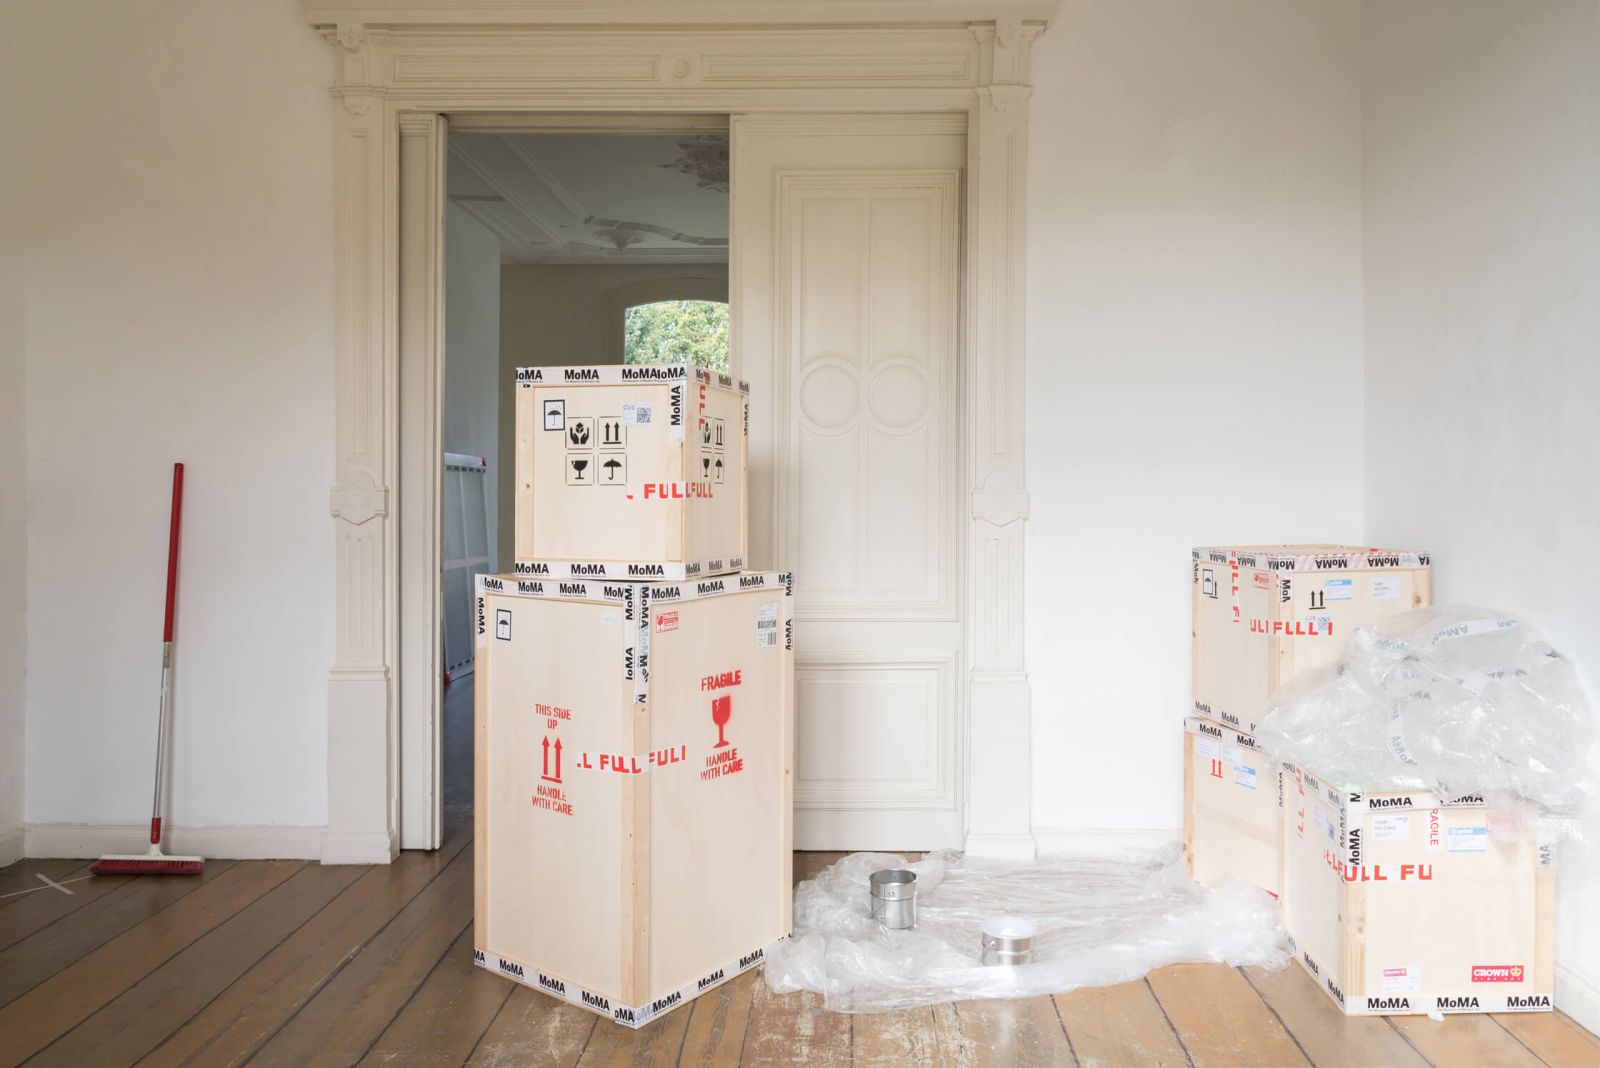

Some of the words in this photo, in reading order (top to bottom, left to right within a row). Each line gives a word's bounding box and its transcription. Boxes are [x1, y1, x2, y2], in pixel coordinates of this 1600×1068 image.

[564, 369, 600, 380] MoMA
[622, 368, 658, 379] MoMA
[671, 386, 681, 426] MoMA
[515, 563, 549, 574] MoMA
[571, 564, 606, 575] MoMA
[628, 565, 664, 575] MoMA
[685, 563, 700, 575] MoMA
[708, 560, 722, 571] MoMA
[730, 558, 742, 569] MoMA
[1237, 557, 1256, 568] MoMA
[1268, 560, 1295, 570] MoMA
[1315, 559, 1347, 569] MoMA
[1367, 557, 1399, 567] MoMA
[518, 582, 543, 593] MoMA
[560, 583, 586, 595] MoMA
[652, 587, 680, 599] MoMA
[697, 581, 724, 594] MoMA
[740, 576, 764, 587] MoMA
[641, 587, 649, 628] MoMA
[701, 669, 741, 691] FRAGILE
[535, 704, 552, 716] THIS
[554, 707, 571, 720] SIDE
[1195, 701, 1211, 714] MoMA
[1221, 711, 1239, 726] MoMA
[547, 719, 558, 730] UP
[1200, 724, 1222, 738] MoMA
[706, 749, 737, 767] HANDLE
[701, 766, 720, 781] WITH
[723, 758, 743, 775] CARE
[537, 785, 566, 801] HANDLE
[532, 796, 550, 809] WITH
[553, 802, 573, 816] CARE
[1369, 797, 1412, 808] MoMA
[1401, 864, 1432, 880] FU
[652, 991, 681, 1012] MoMA
[698, 969, 724, 988] MoMA
[740, 948, 763, 968] MoMA
[1304, 952, 1319, 976] MoMA
[1328, 978, 1344, 1005] MoMA
[1473, 969, 1509, 977] CROWN
[500, 959, 524, 977] MoMA
[539, 974, 565, 993] MoMA
[582, 991, 609, 1010] MoMA
[1367, 998, 1410, 1008] MoMA
[1437, 997, 1479, 1007] MoMA
[1507, 996, 1550, 1006] MoMA
